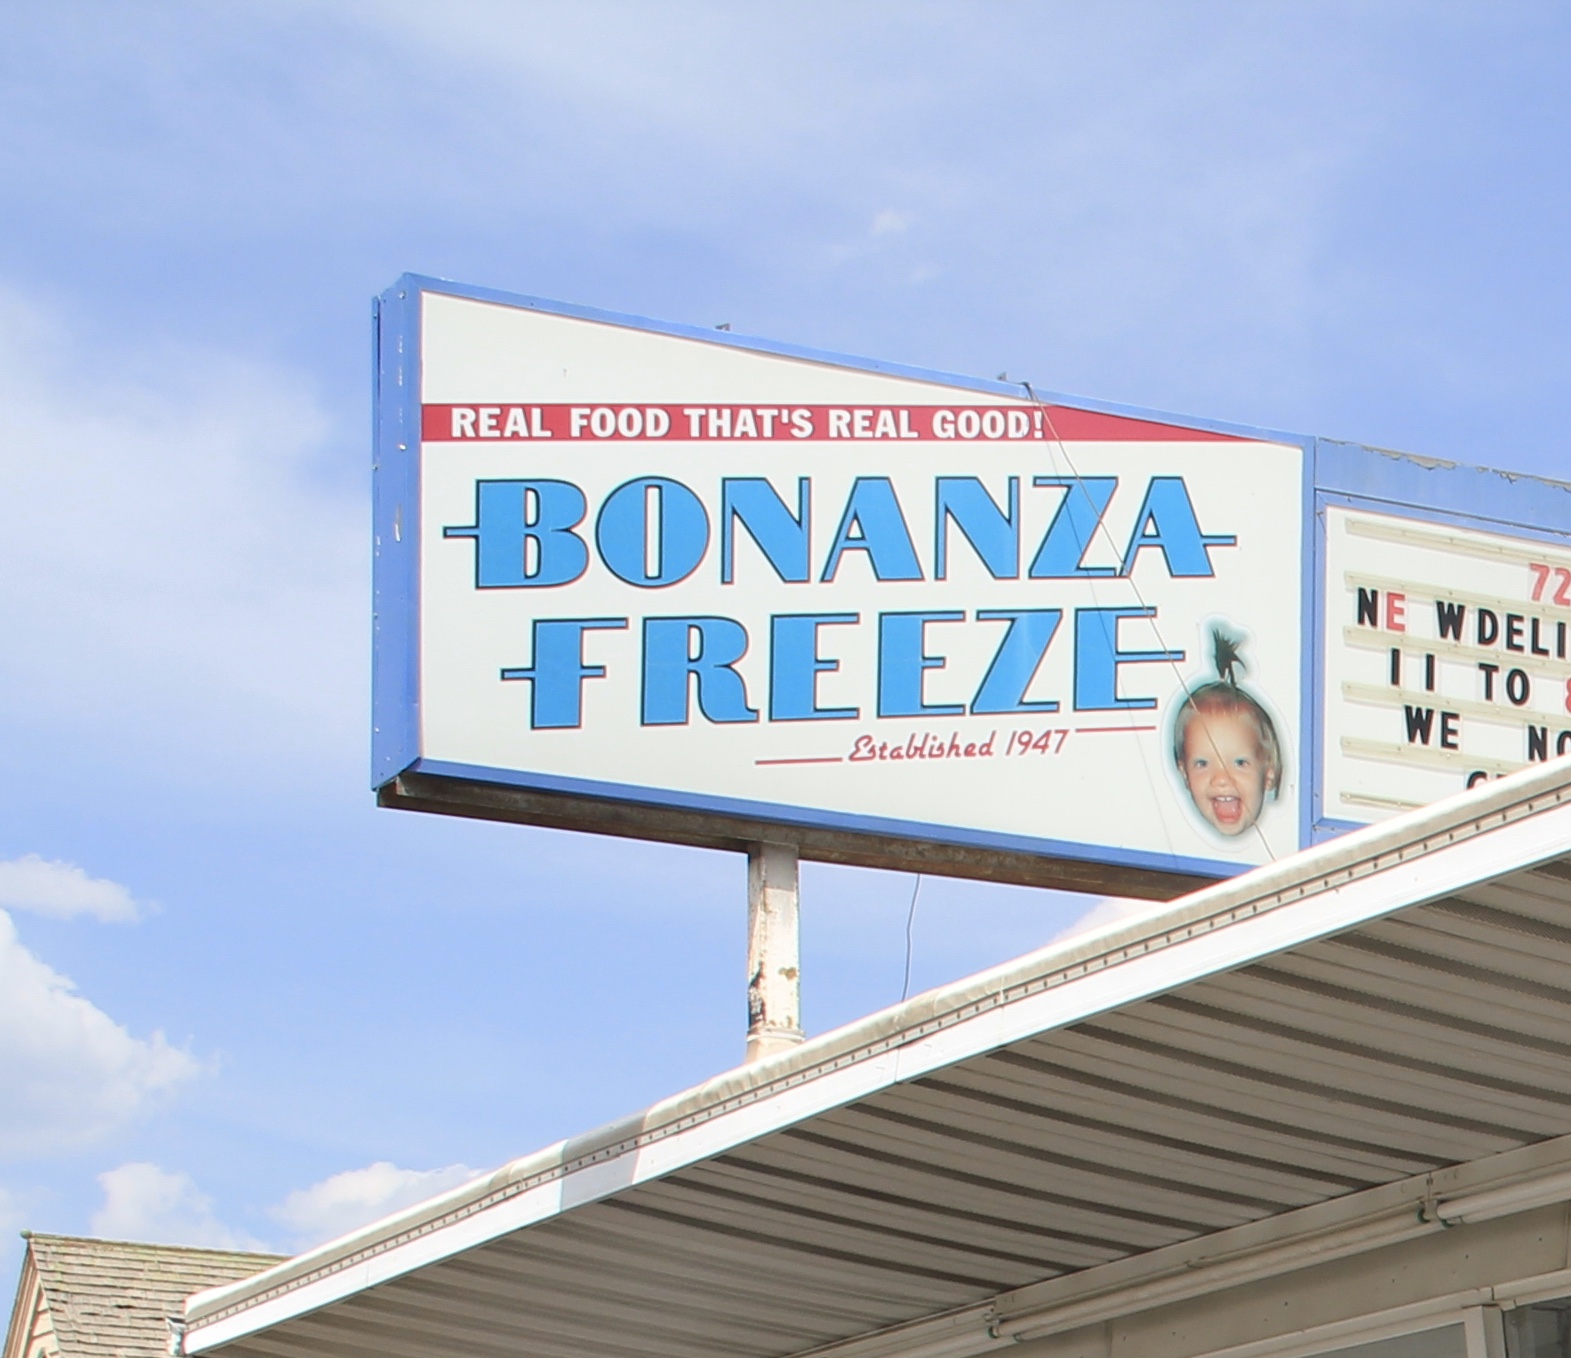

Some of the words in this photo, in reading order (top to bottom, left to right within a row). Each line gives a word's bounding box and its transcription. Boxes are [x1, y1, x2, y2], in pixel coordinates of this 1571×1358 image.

[450, 407, 552, 438] REAL
[570, 407, 671, 438] FOOD
[683, 408, 813, 439] THAT'S
[828, 408, 919, 439] REAL
[932, 408, 1046, 440] GOOD!
[443, 475, 1238, 590] BONANZA
[500, 605, 1187, 730] FREEZE
[1478, 661, 1531, 706] TO
[848, 730, 997, 762] Established
[1005, 729, 1070, 756] 1947
[1404, 704, 1460, 750] WE
